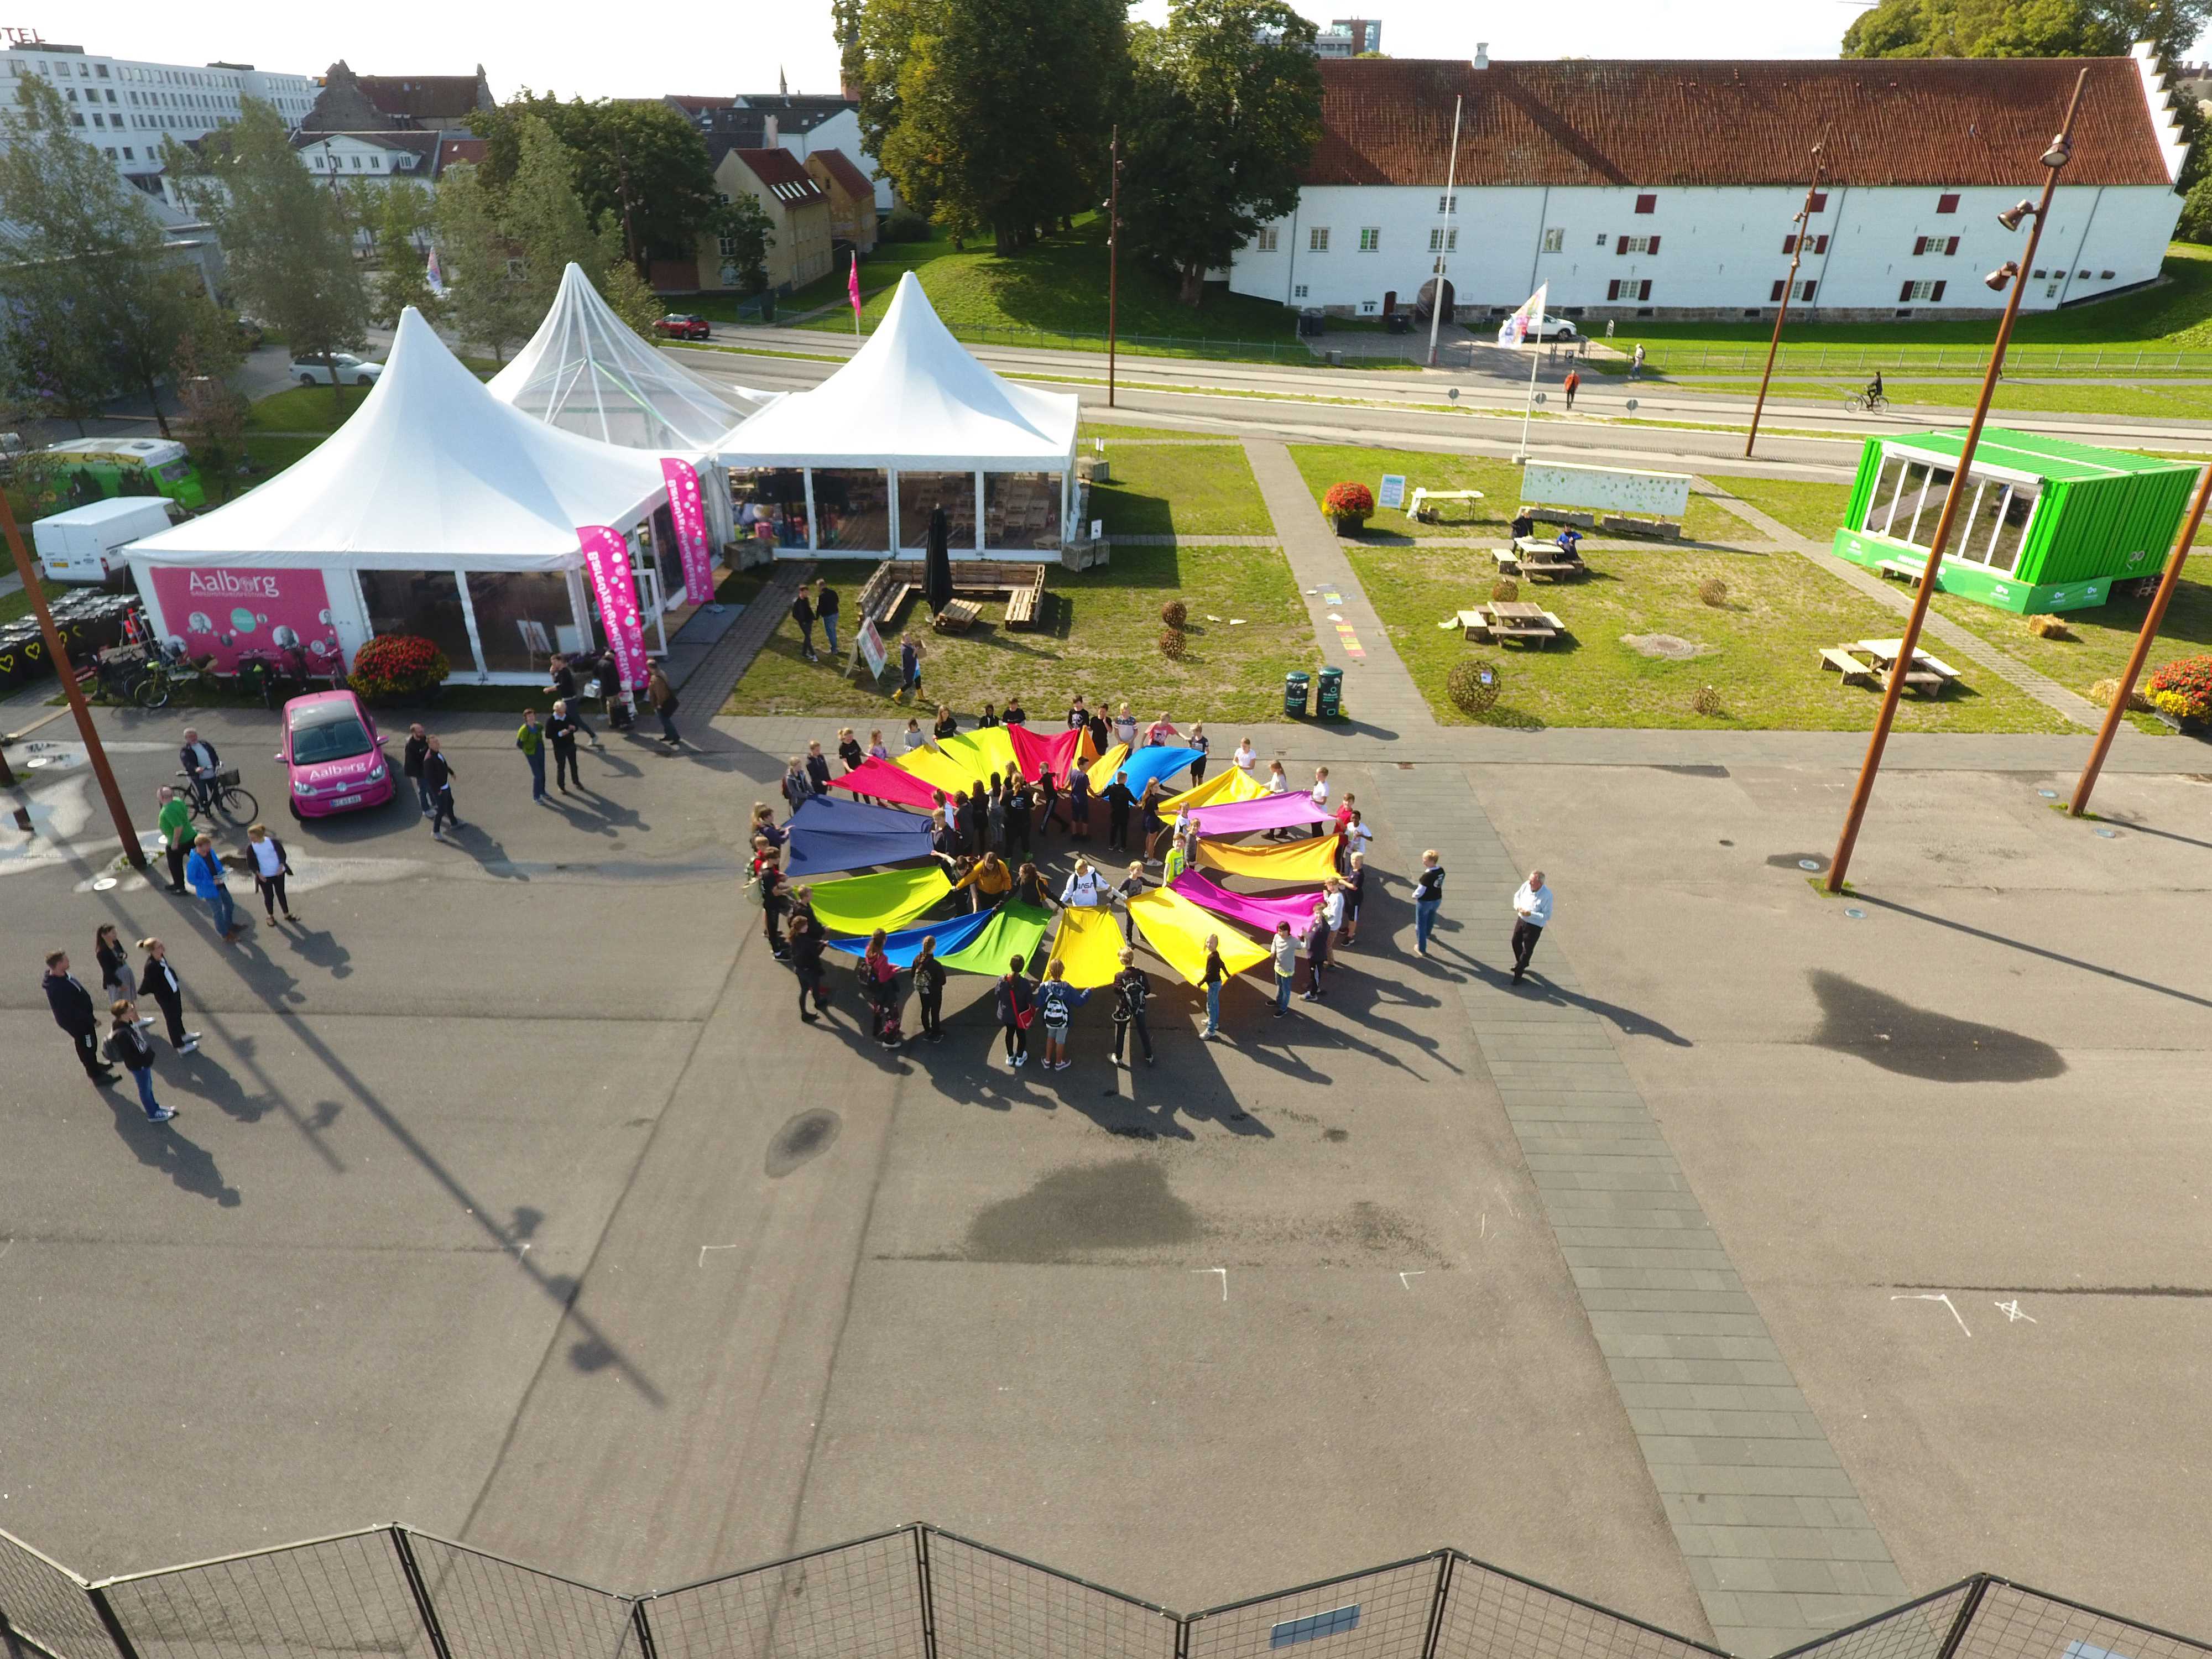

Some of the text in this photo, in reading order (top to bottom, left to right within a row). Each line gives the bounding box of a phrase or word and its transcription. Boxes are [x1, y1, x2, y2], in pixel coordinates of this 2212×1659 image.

[0, 27, 45, 43] TEL
[190, 570, 279, 598] Aalborg
[310, 763, 366, 781] Aalborg
